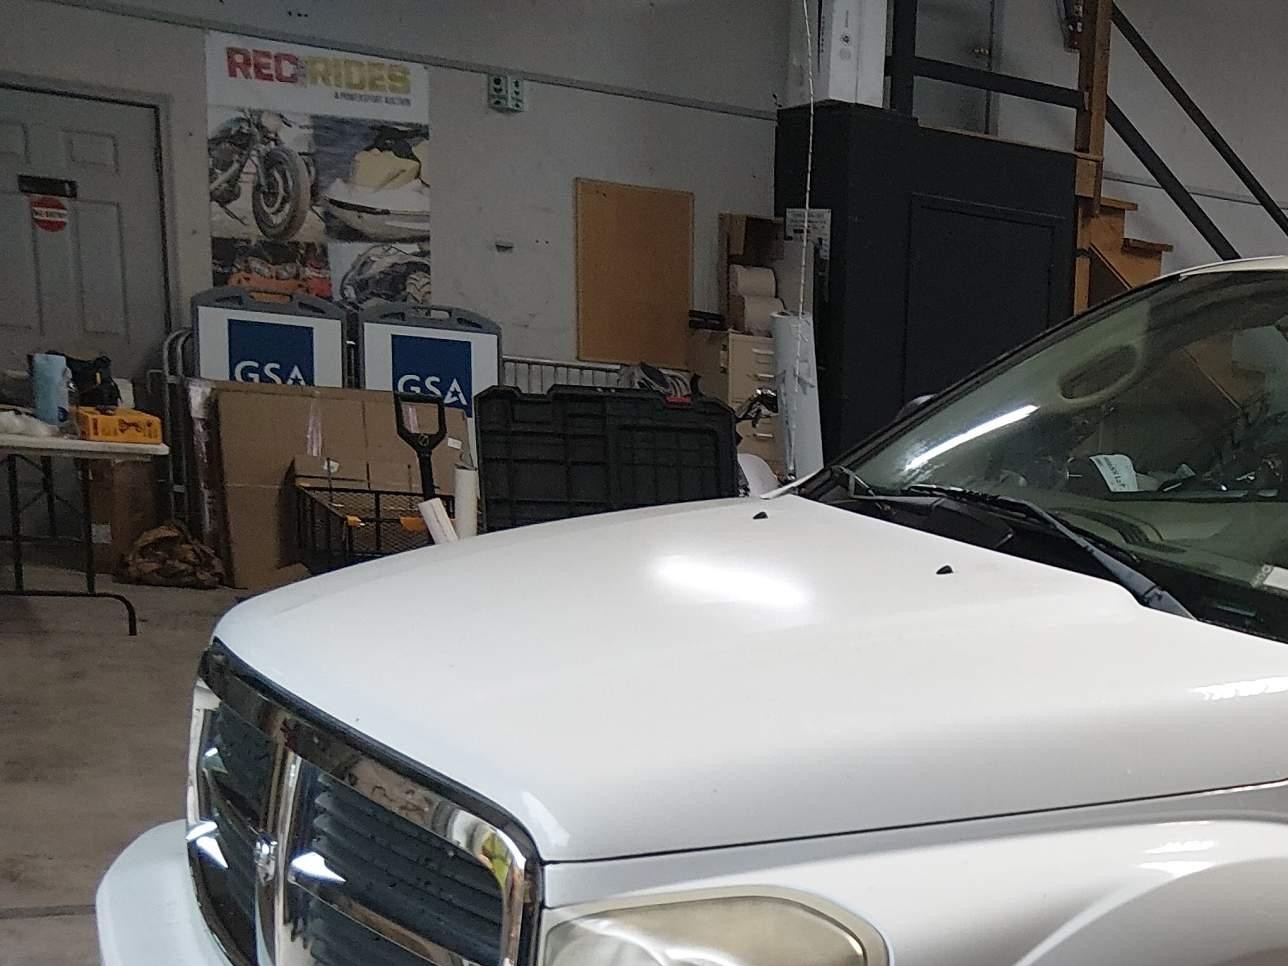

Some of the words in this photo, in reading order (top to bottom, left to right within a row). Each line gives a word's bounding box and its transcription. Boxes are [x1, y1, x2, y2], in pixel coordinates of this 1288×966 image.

[226, 47, 300, 83] REC
[304, 56, 411, 94] RIDES
[235, 360, 306, 386] GSA
[398, 374, 467, 405] GSA
